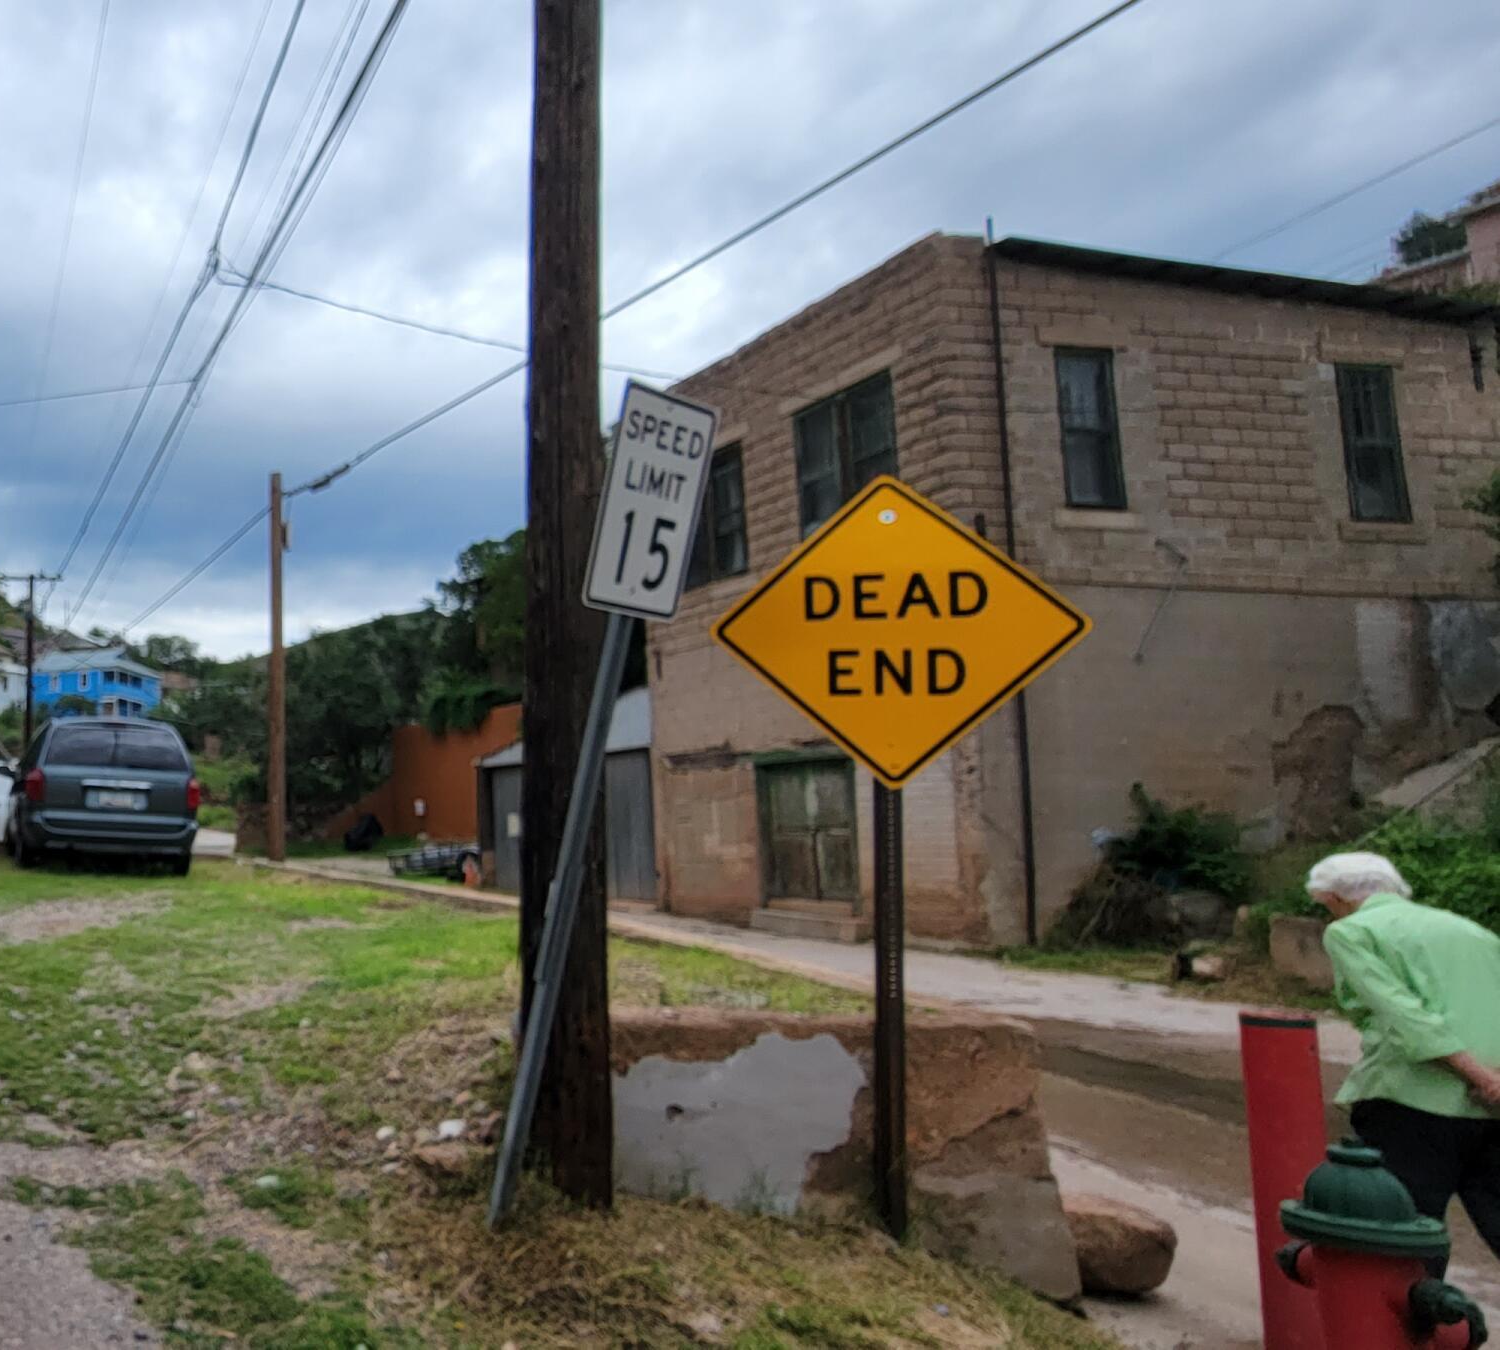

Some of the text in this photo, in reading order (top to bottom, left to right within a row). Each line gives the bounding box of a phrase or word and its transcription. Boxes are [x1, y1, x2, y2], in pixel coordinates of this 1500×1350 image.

[626, 410, 705, 460] SPEED
[625, 459, 687, 503] LIMIT
[614, 510, 677, 591] 15
[804, 571, 989, 620] DEAD
[828, 649, 966, 695] END
